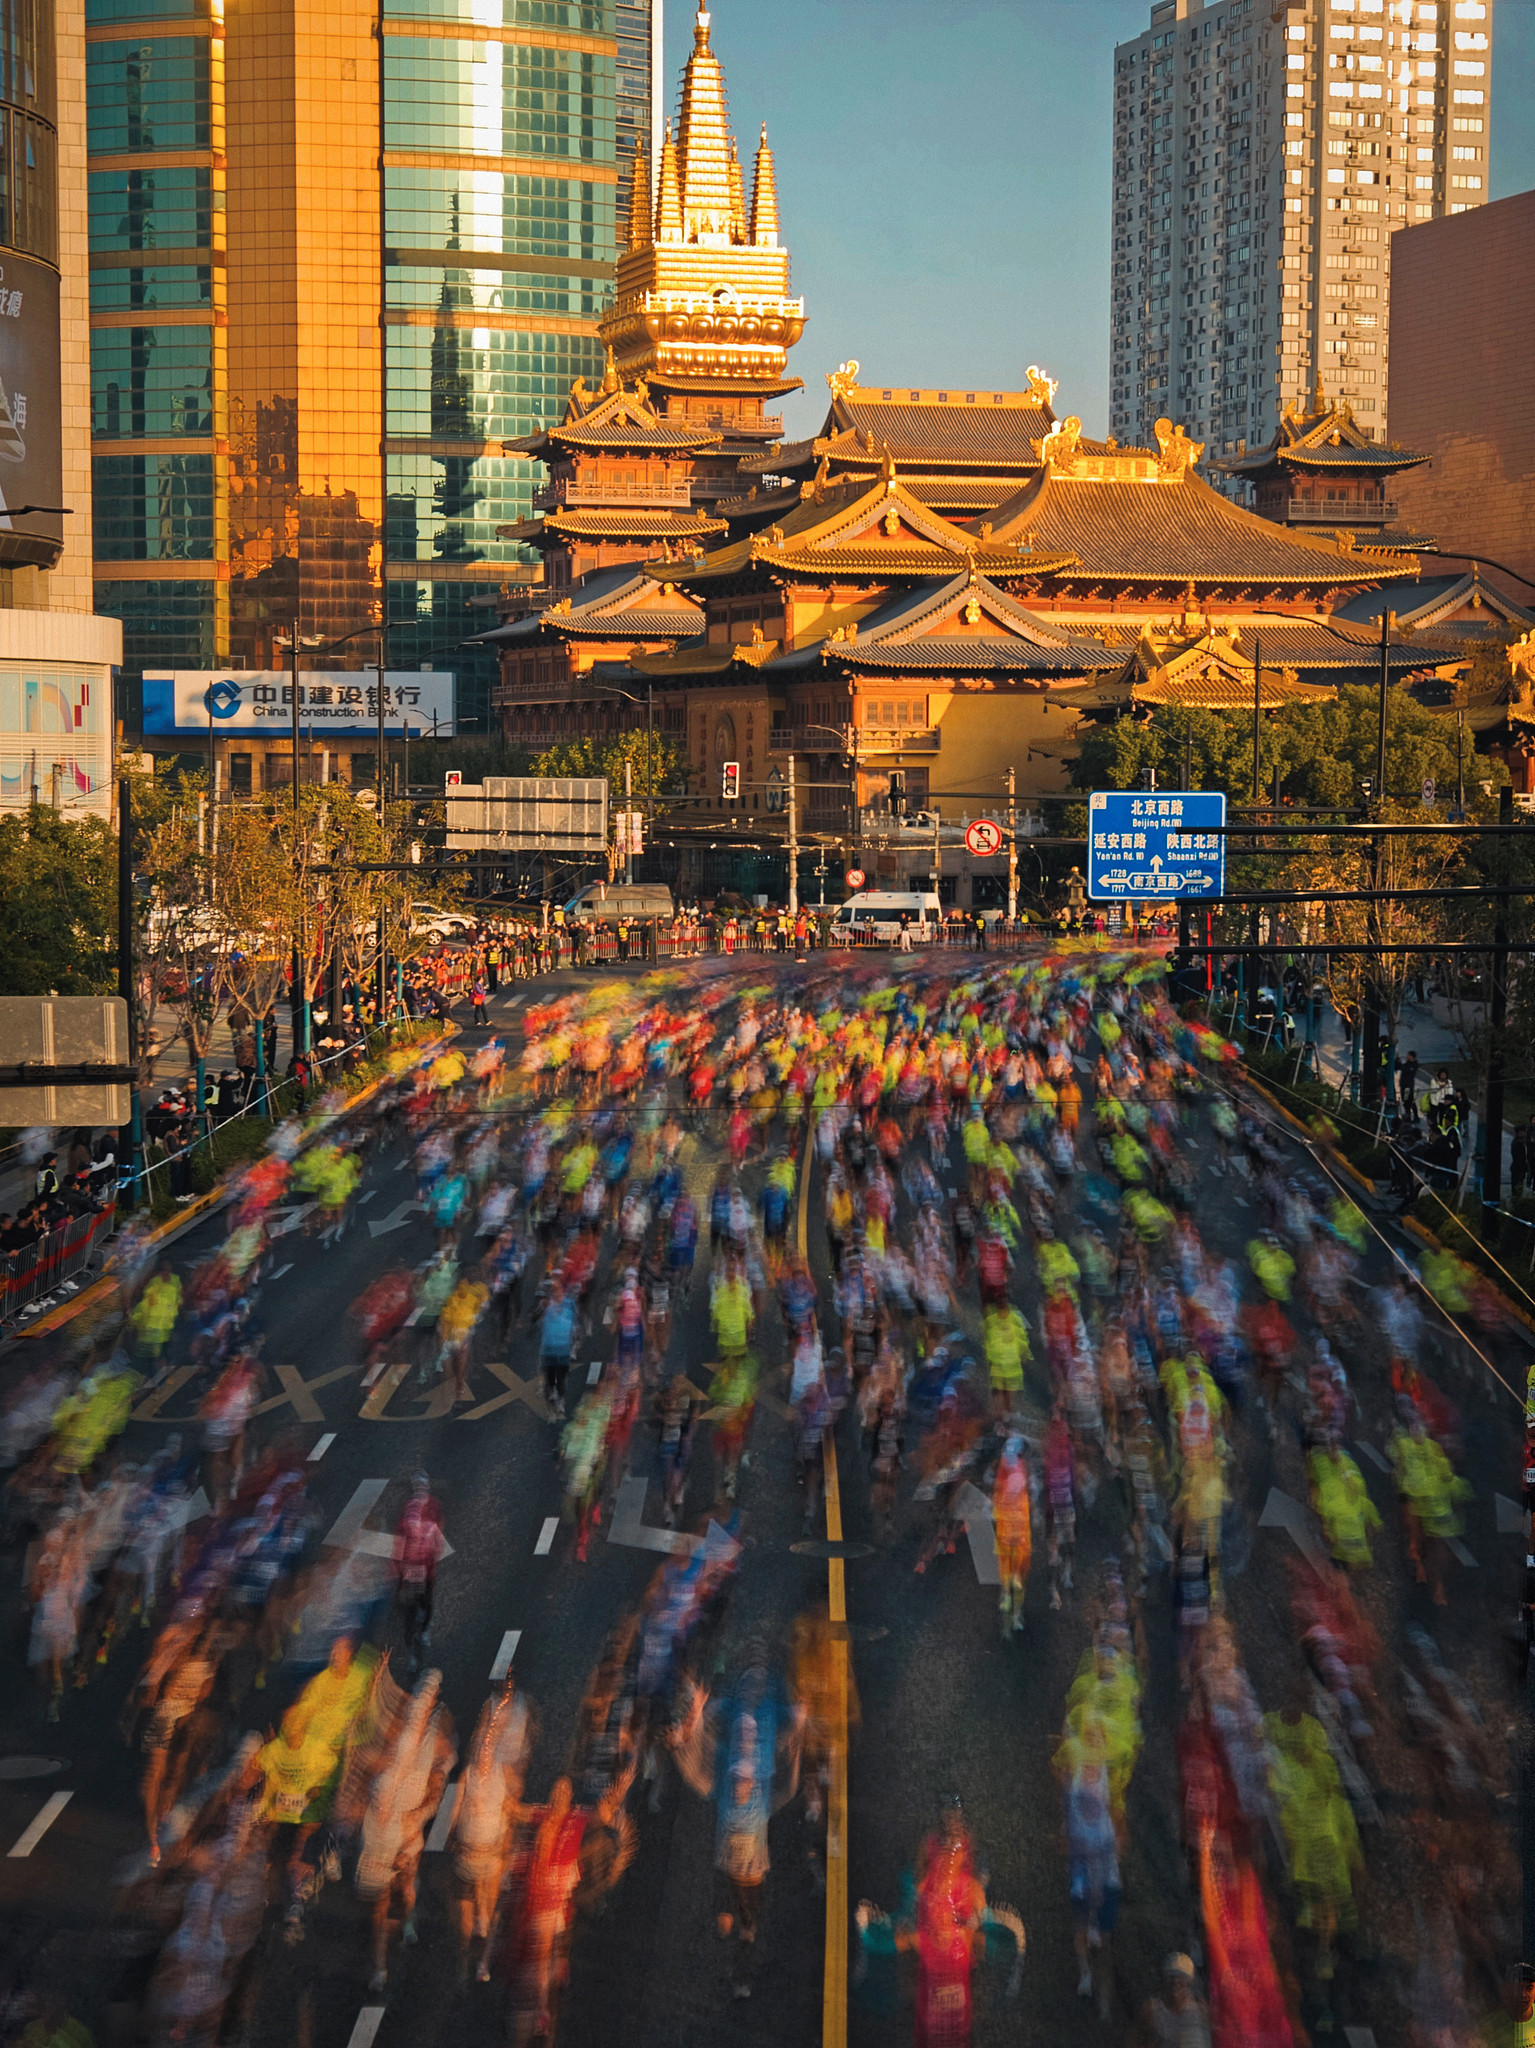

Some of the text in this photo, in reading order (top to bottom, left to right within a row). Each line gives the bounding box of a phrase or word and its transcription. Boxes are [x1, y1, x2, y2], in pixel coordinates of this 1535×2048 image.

[253, 685, 421, 707] 中国建设银行
[253, 706, 288, 716] China
[368, 707, 399, 717] Bnk
[1131, 799, 1184, 816] 北京西路
[1132, 818, 1159, 829] Beijing
[1094, 833, 1147, 849] 延安西路
[1166, 833, 1219, 849] 陕西北路
[1096, 851, 1121, 861] Yan'an
[1167, 851, 1197, 861] Shaanxi
[1110, 869, 1127, 878] 1728
[1186, 869, 1202, 878] 1688
[1133, 874, 1179, 888] 南京西路
[1111, 884, 1125, 893] 1717
[1187, 885, 1202, 894] 1661
